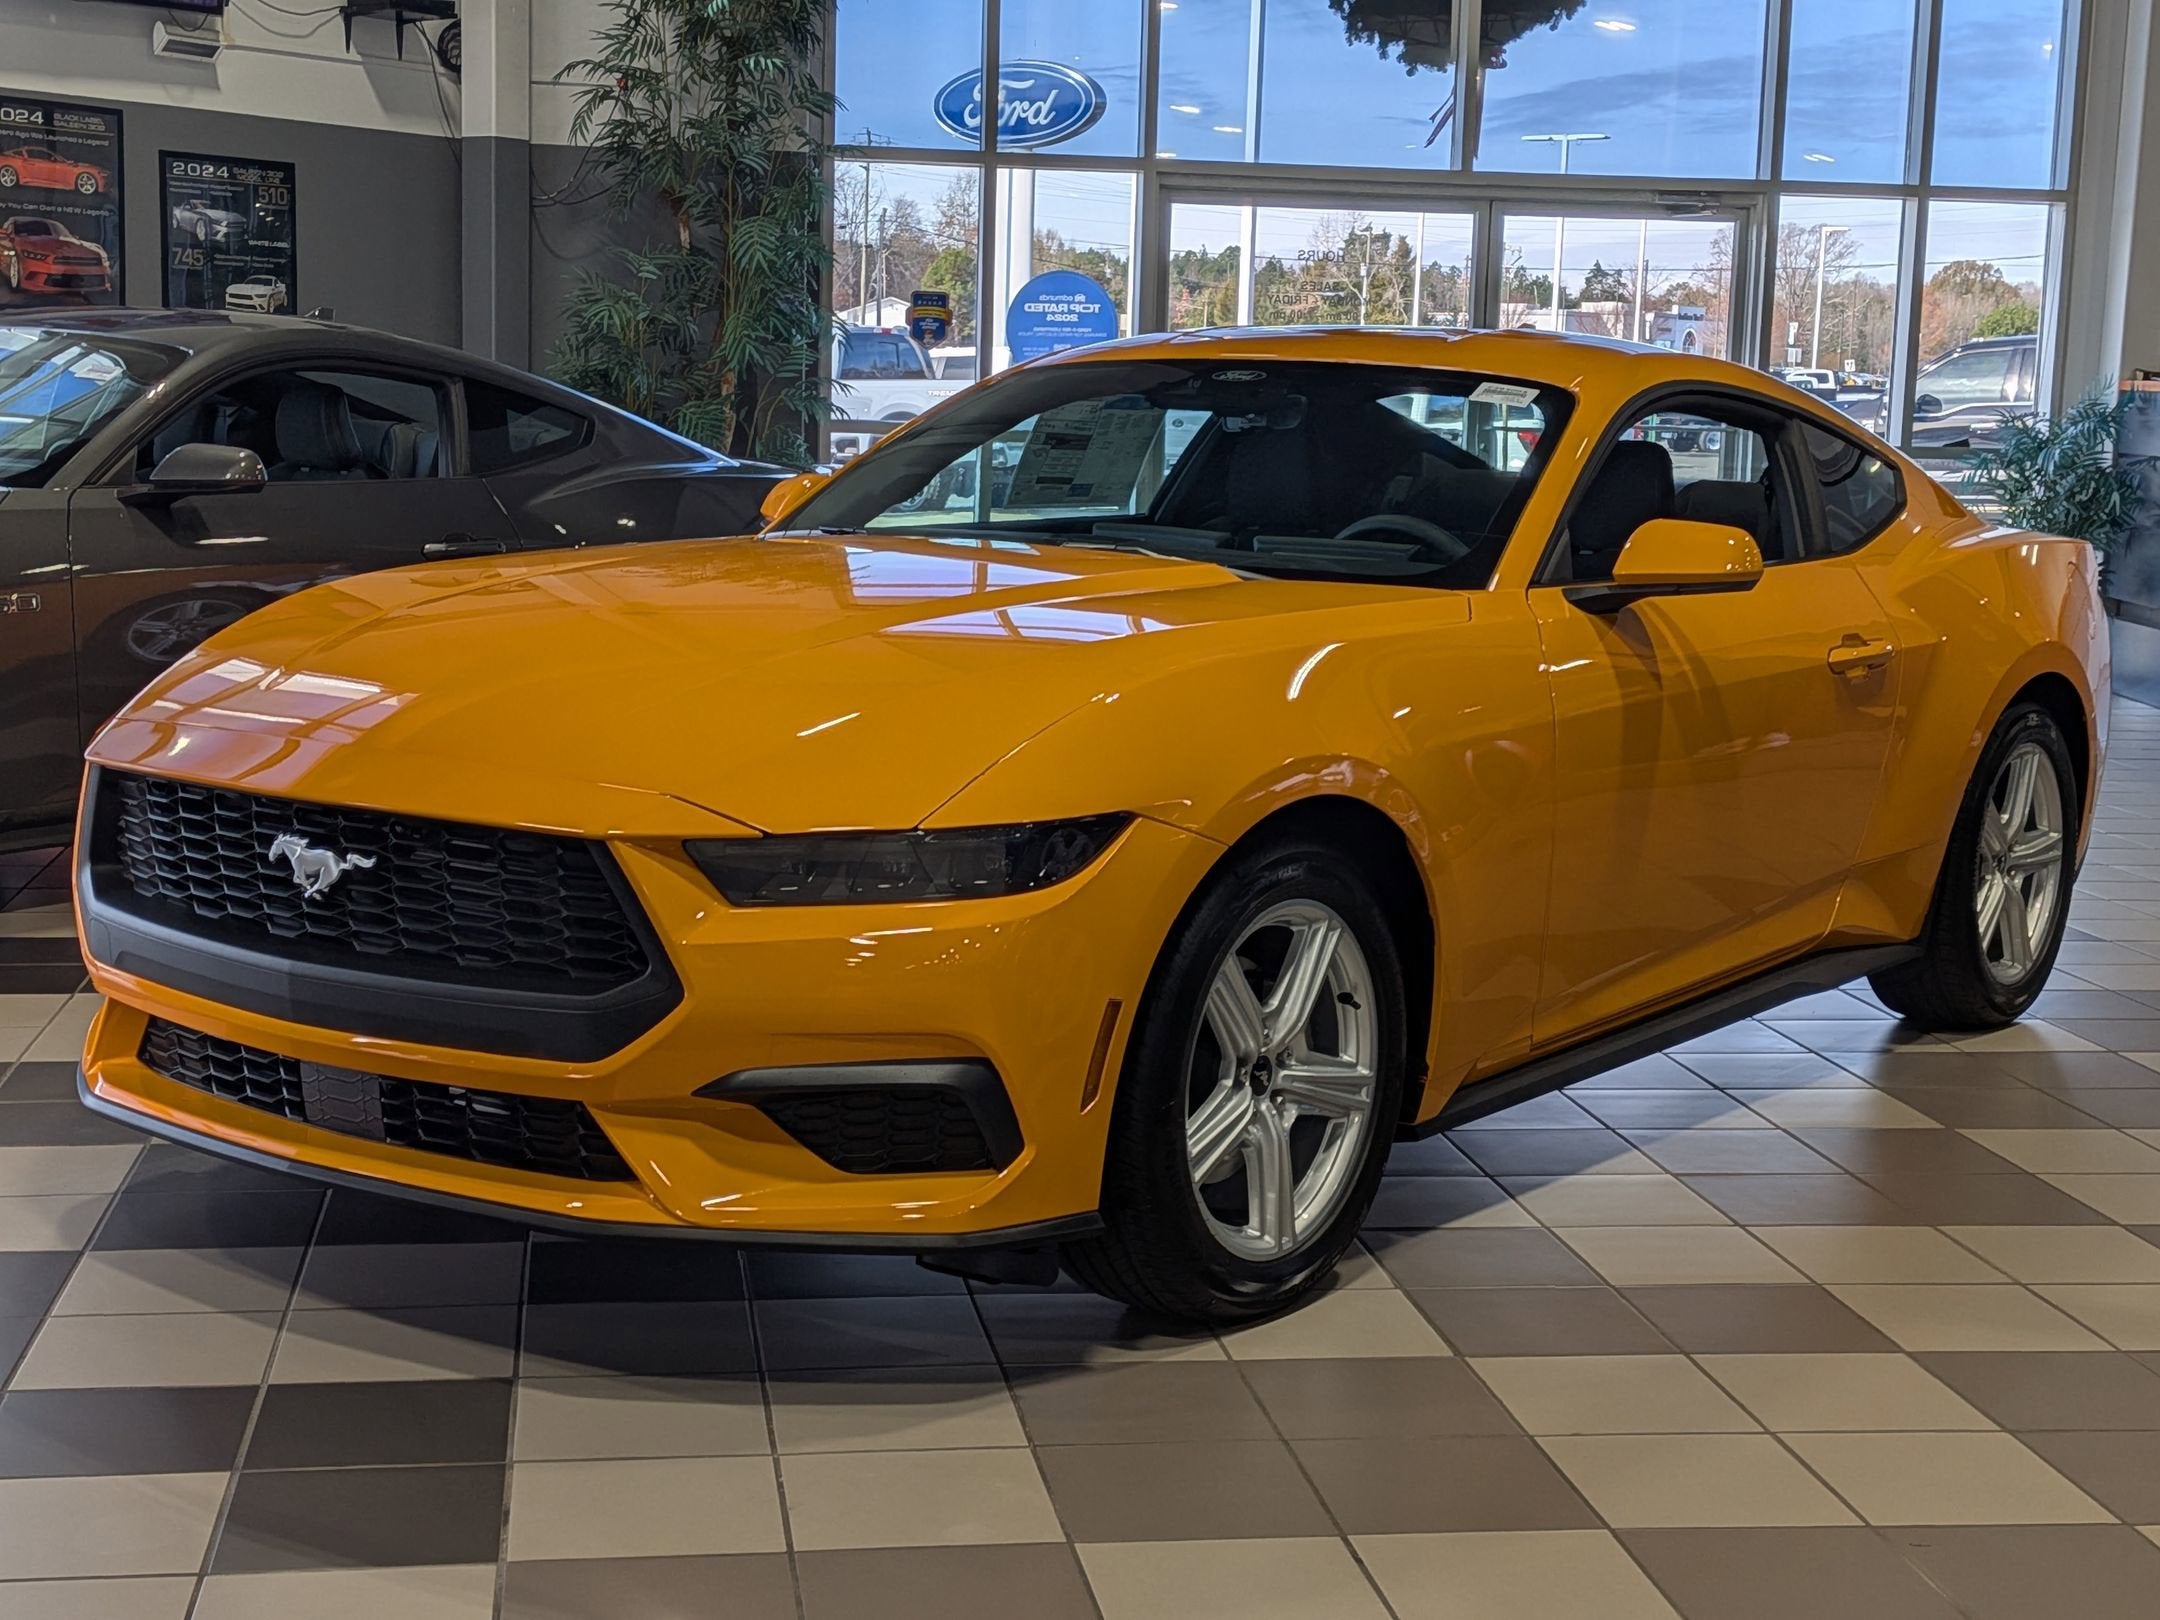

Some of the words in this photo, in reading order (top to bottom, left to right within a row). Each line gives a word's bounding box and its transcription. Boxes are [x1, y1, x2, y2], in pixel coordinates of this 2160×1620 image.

[964, 79, 1059, 128] Ford
[0, 107, 44, 124] 024
[172, 162, 229, 178] 2024
[258, 186, 288, 204] 510
[172, 247, 204, 266] 745
